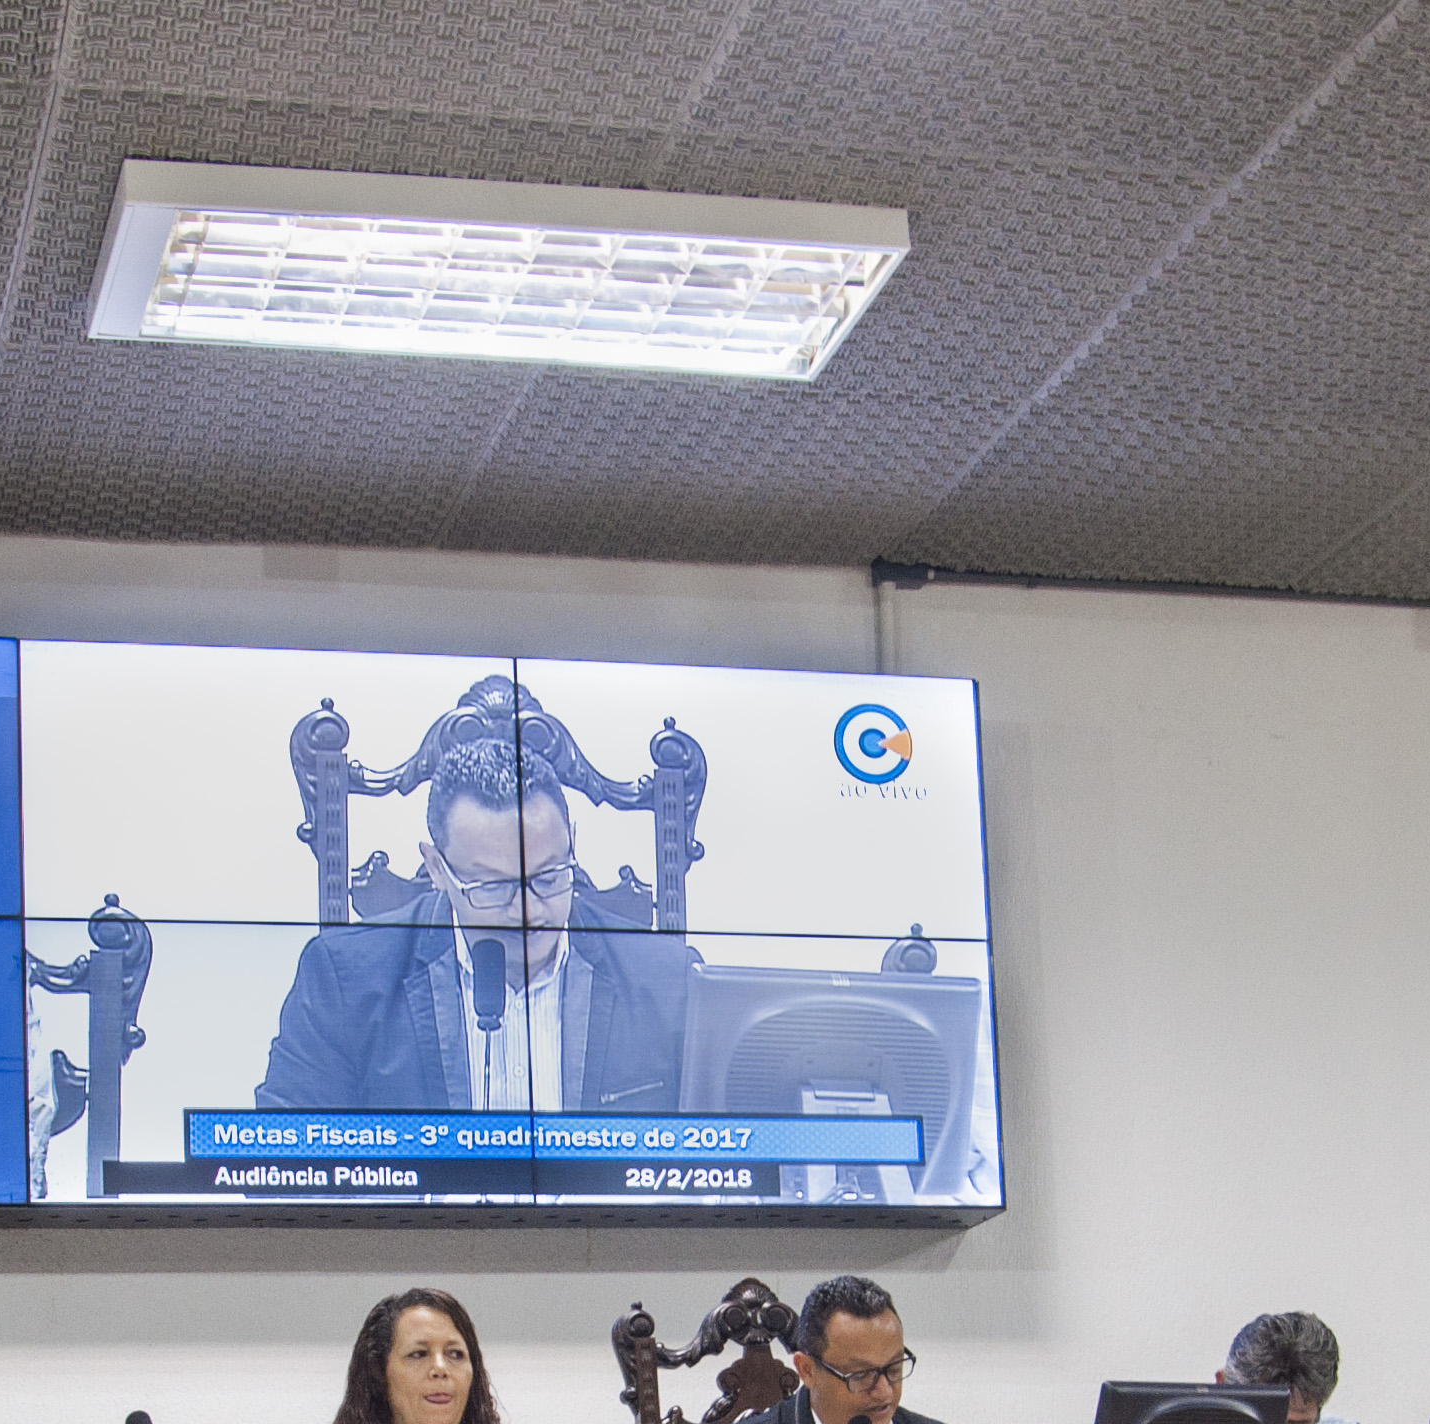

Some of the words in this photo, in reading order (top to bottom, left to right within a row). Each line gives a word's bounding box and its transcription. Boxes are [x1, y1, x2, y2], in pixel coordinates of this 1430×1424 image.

[214, 1124, 298, 1145] Metas
[306, 1124, 398, 1146] Fiscais
[457, 1126, 637, 1149] quadrimestre
[643, 1127, 675, 1147] de
[683, 1127, 752, 1148] 2017
[214, 1165, 328, 1186] Audiência
[334, 1165, 419, 1186] Pública
[625, 1168, 753, 1191] 28/2/2018
